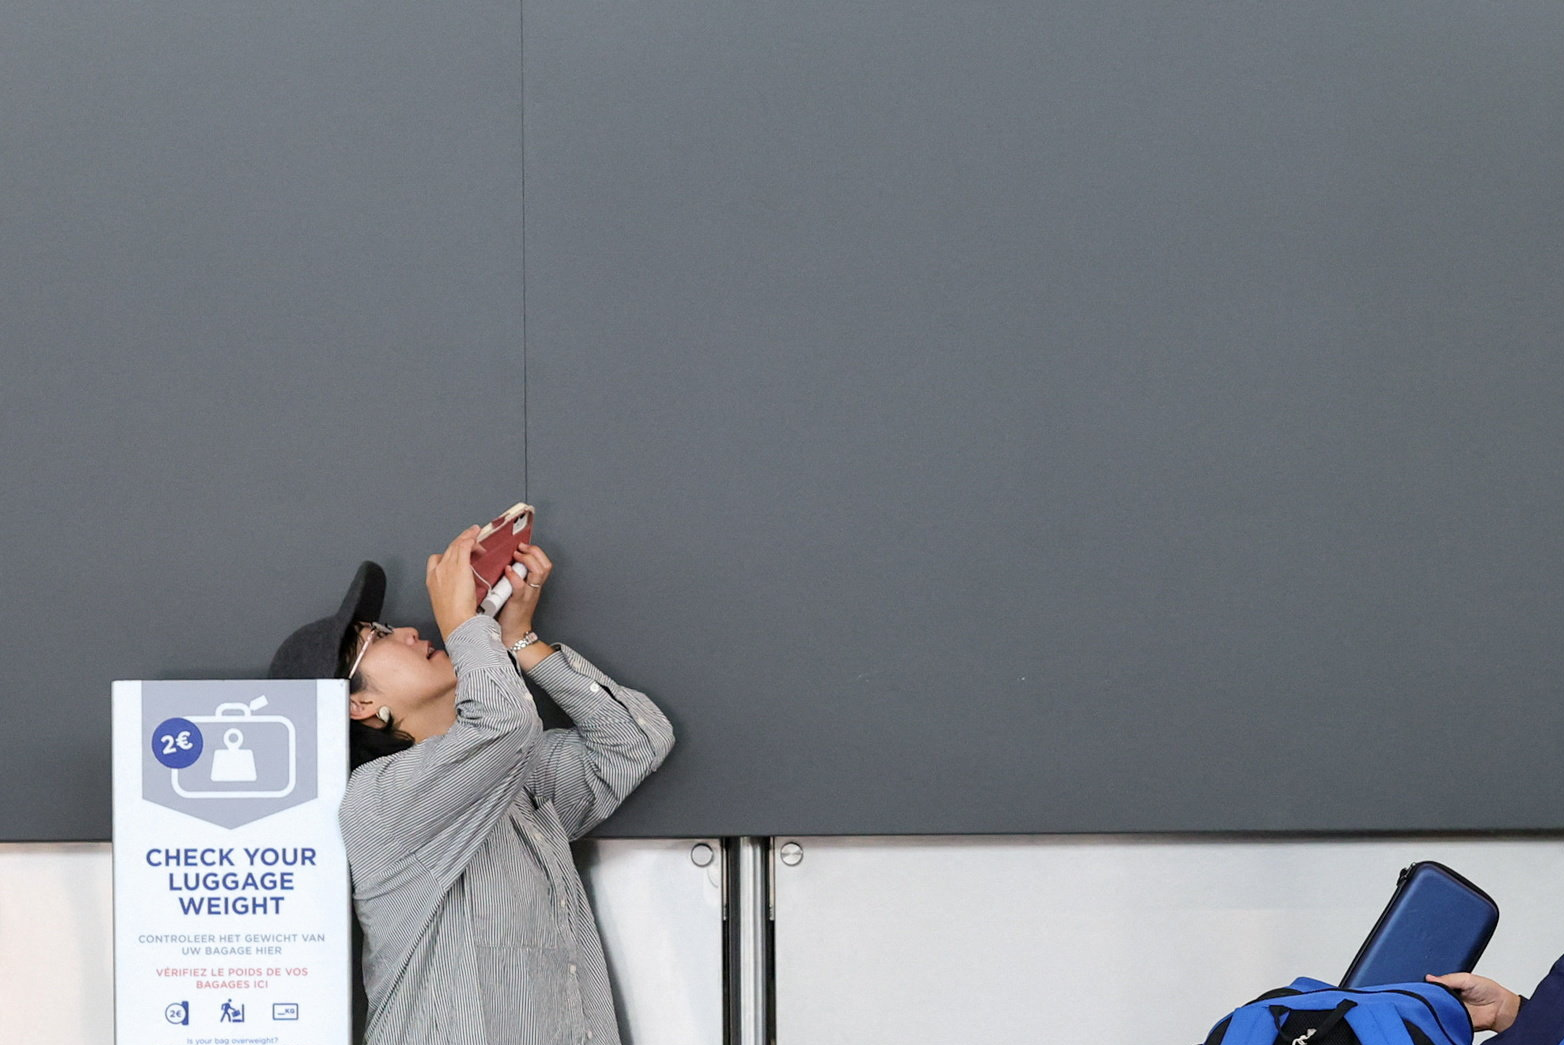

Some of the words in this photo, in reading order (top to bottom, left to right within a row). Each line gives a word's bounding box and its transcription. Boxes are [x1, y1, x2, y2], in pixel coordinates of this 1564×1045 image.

[161, 731, 193, 754] 2€
[146, 848, 235, 867] CHECK
[244, 848, 317, 866] YOUR
[169, 872, 295, 891] LUGGAGE
[179, 896, 285, 915] WEIGHT
[138, 934, 216, 944] CONTROLEER
[219, 934, 241, 943] HET
[244, 933, 298, 943] GEWICHT
[301, 933, 325, 942] VAN
[181, 946, 201, 955] UW
[205, 946, 252, 955] BAGAGE
[256, 946, 282, 955] HIER
[156, 967, 208, 977] VÉRIFIEZ
[211, 968, 224, 977] LE
[228, 968, 263, 977] POIDS
[266, 968, 281, 976] DE
[285, 967, 309, 976] VOS
[196, 980, 250, 989] BAGAGES
[254, 980, 268, 989] ICI
[215, 1037, 229, 1045] bag
[232, 1037, 279, 1045] overweight?
